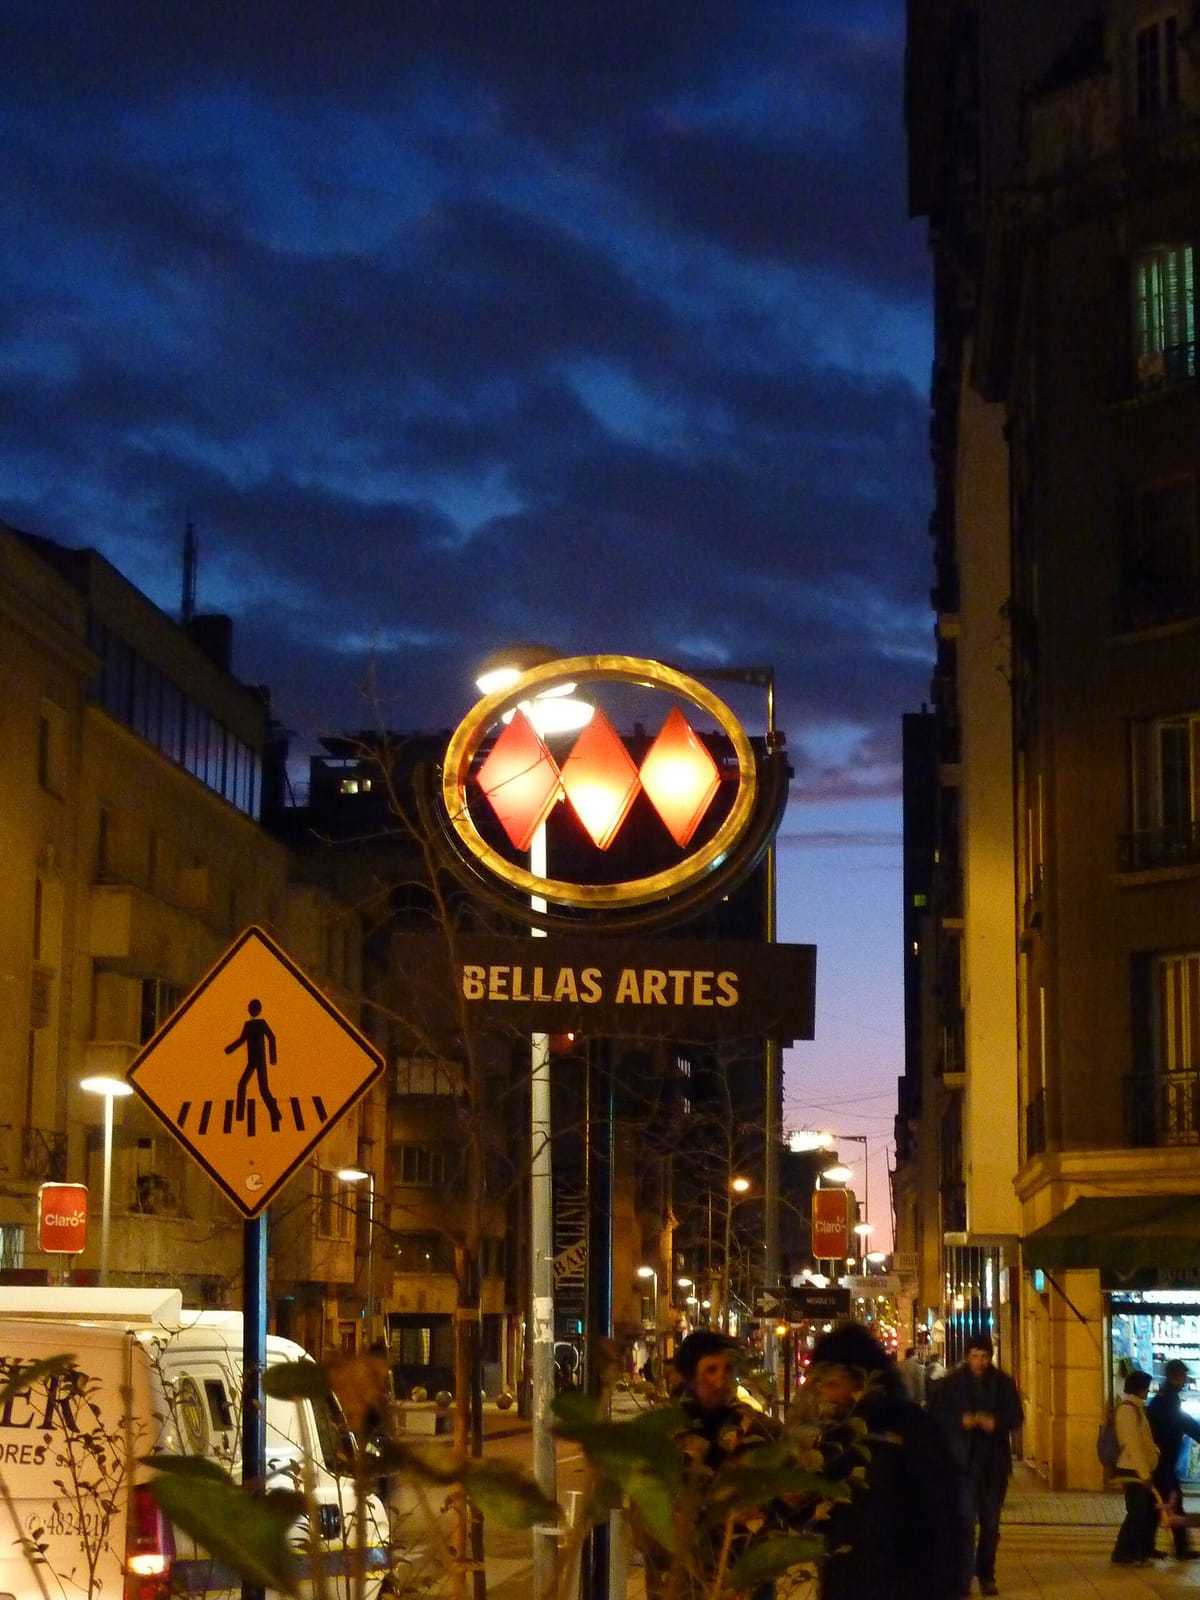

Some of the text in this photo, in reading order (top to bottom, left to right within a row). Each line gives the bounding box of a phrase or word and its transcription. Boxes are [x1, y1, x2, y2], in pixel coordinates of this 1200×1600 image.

[462, 964, 739, 1007] BELLAS ARTES
[45, 1213, 80, 1227] Claro
